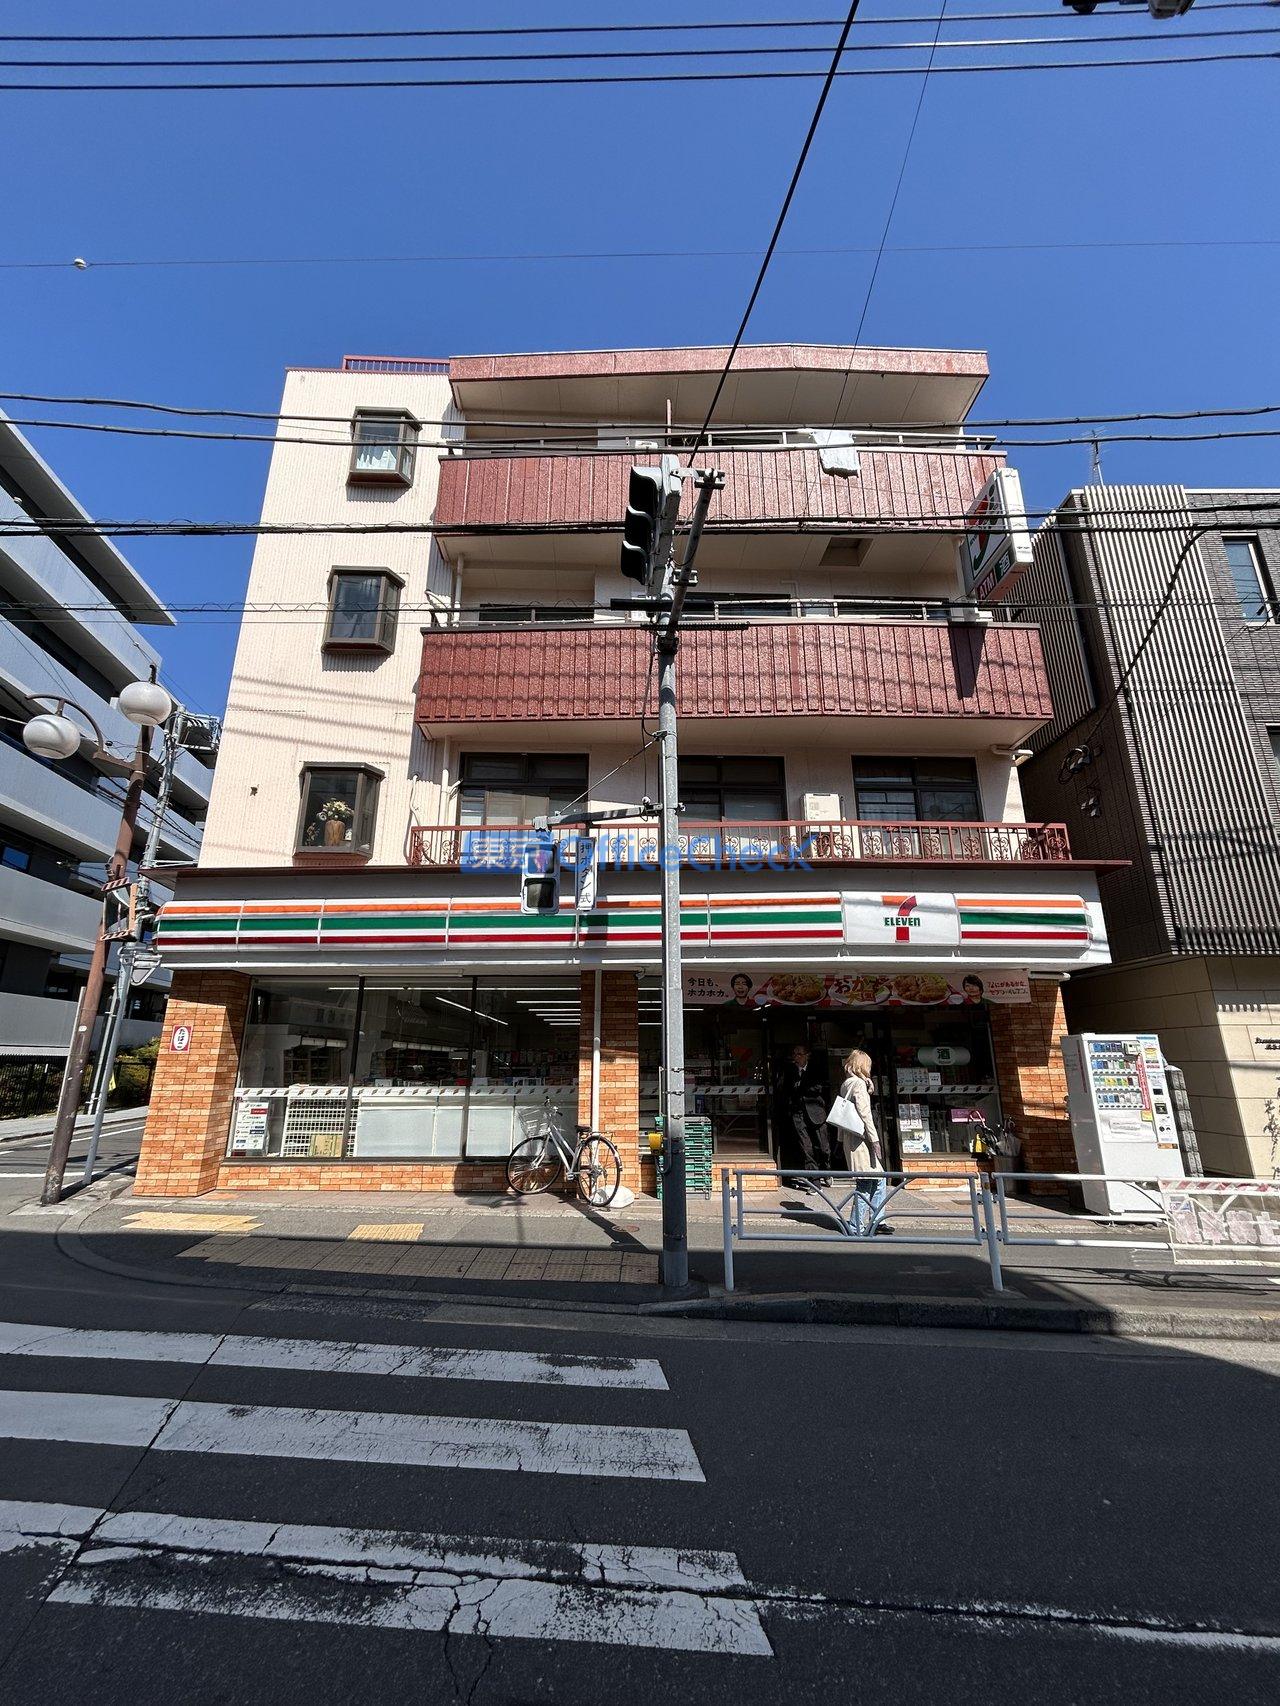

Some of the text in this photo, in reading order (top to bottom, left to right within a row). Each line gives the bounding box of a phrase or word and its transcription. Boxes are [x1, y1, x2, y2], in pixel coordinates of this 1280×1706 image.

[979, 573, 995, 600] ATM
[580, 842, 594, 904] 押ボタン式
[687, 977, 719, 988] 今日も、
[687, 988, 729, 998] ホカホカ。
[937, 1048, 951, 1060] 酒
